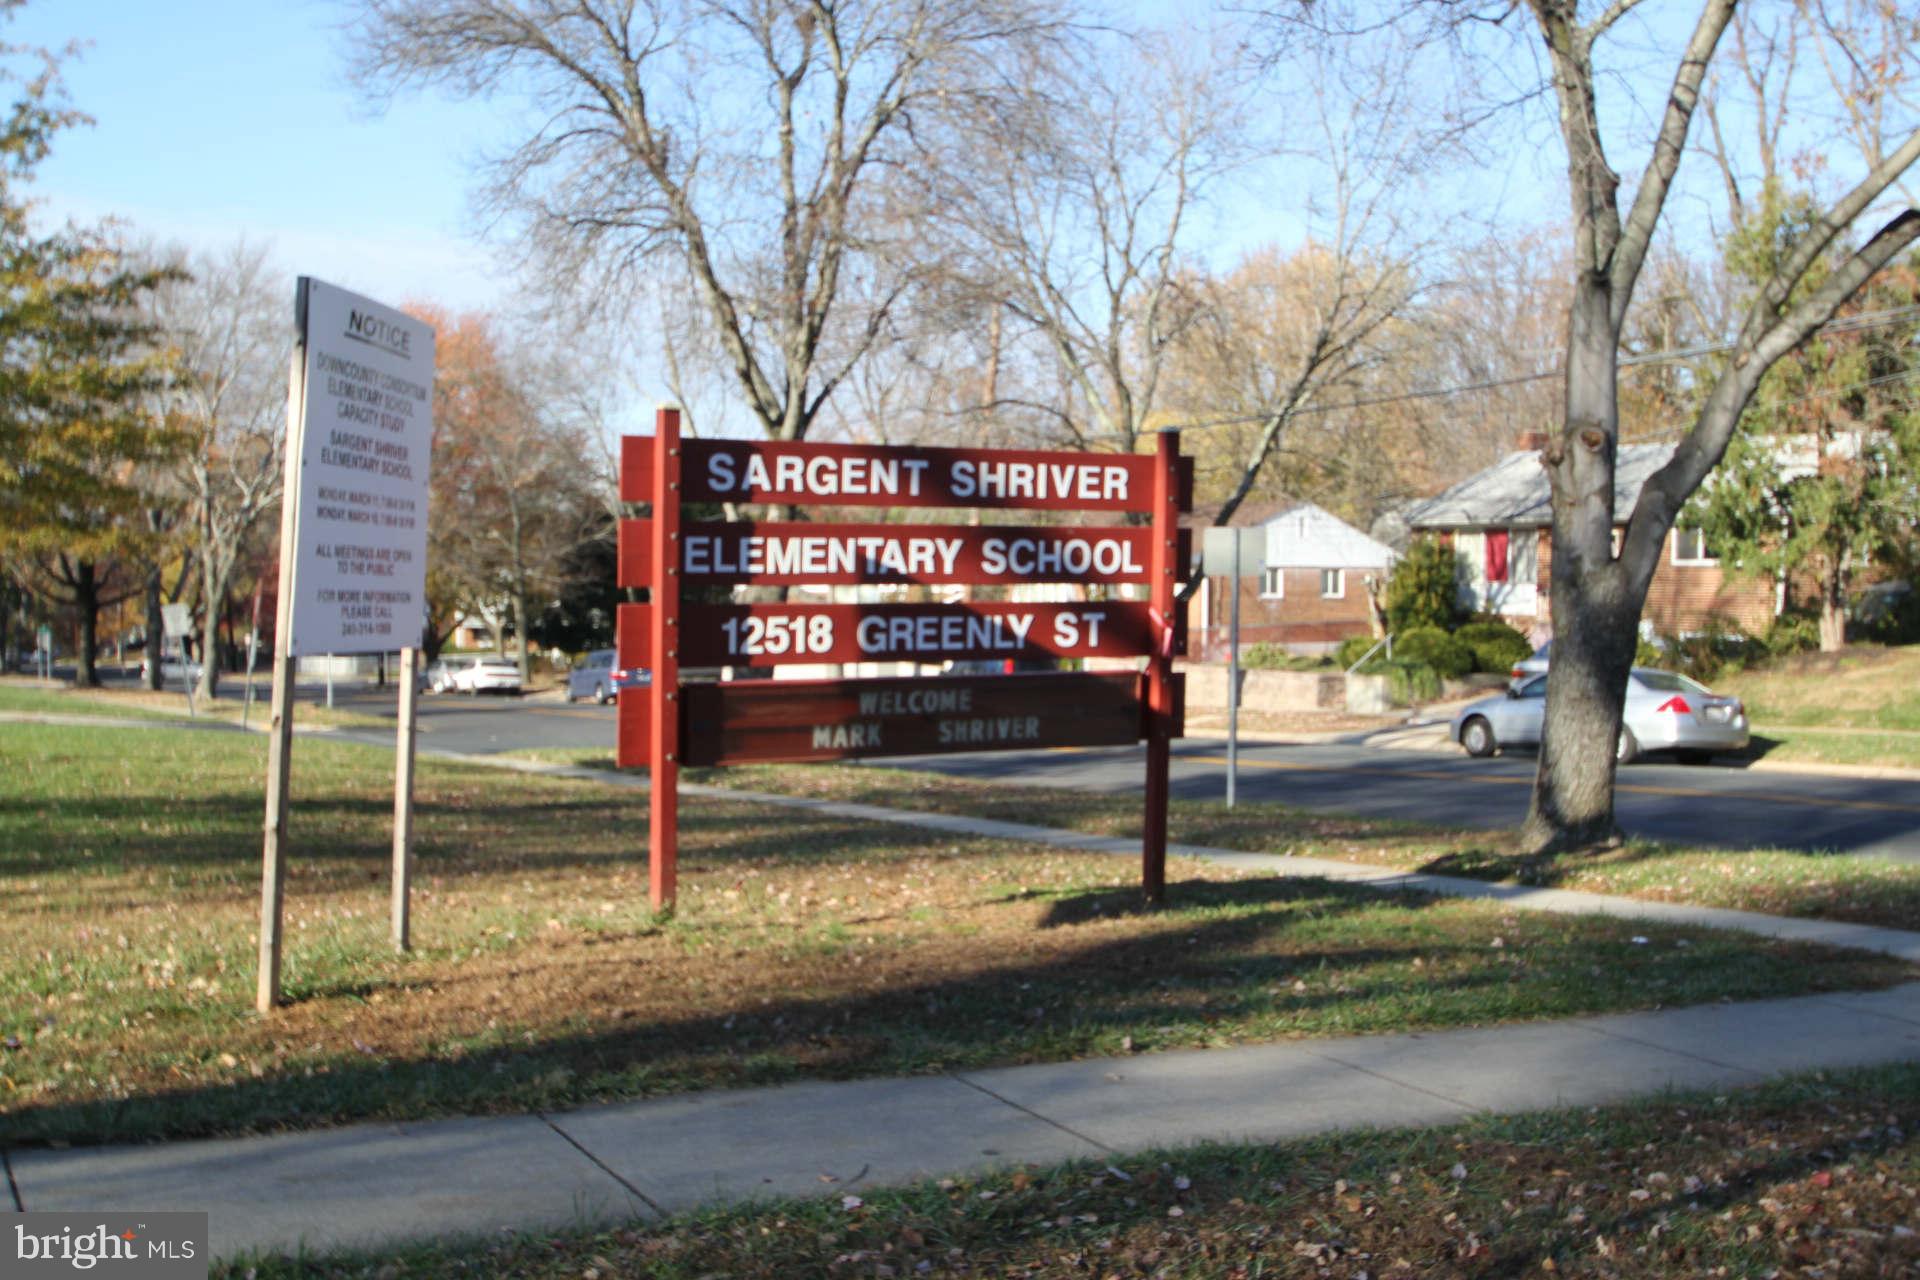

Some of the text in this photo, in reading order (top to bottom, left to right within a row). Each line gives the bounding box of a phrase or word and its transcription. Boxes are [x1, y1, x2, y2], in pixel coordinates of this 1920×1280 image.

[349, 309, 411, 352] NOTICE
[330, 429, 374, 453] SARGENT
[320, 446, 380, 473] ELEMENTARY
[707, 452, 1129, 501] SARGENT SHRIVER
[315, 543, 332, 558] ALL
[684, 536, 1143, 575] ELEMENTARY SCHOOL
[337, 560, 349, 575] TO
[721, 612, 1106, 655] 12518 GREENLY ST
[859, 688, 972, 716] WELCOME
[812, 717, 1040, 750] MARK SHRIVER
